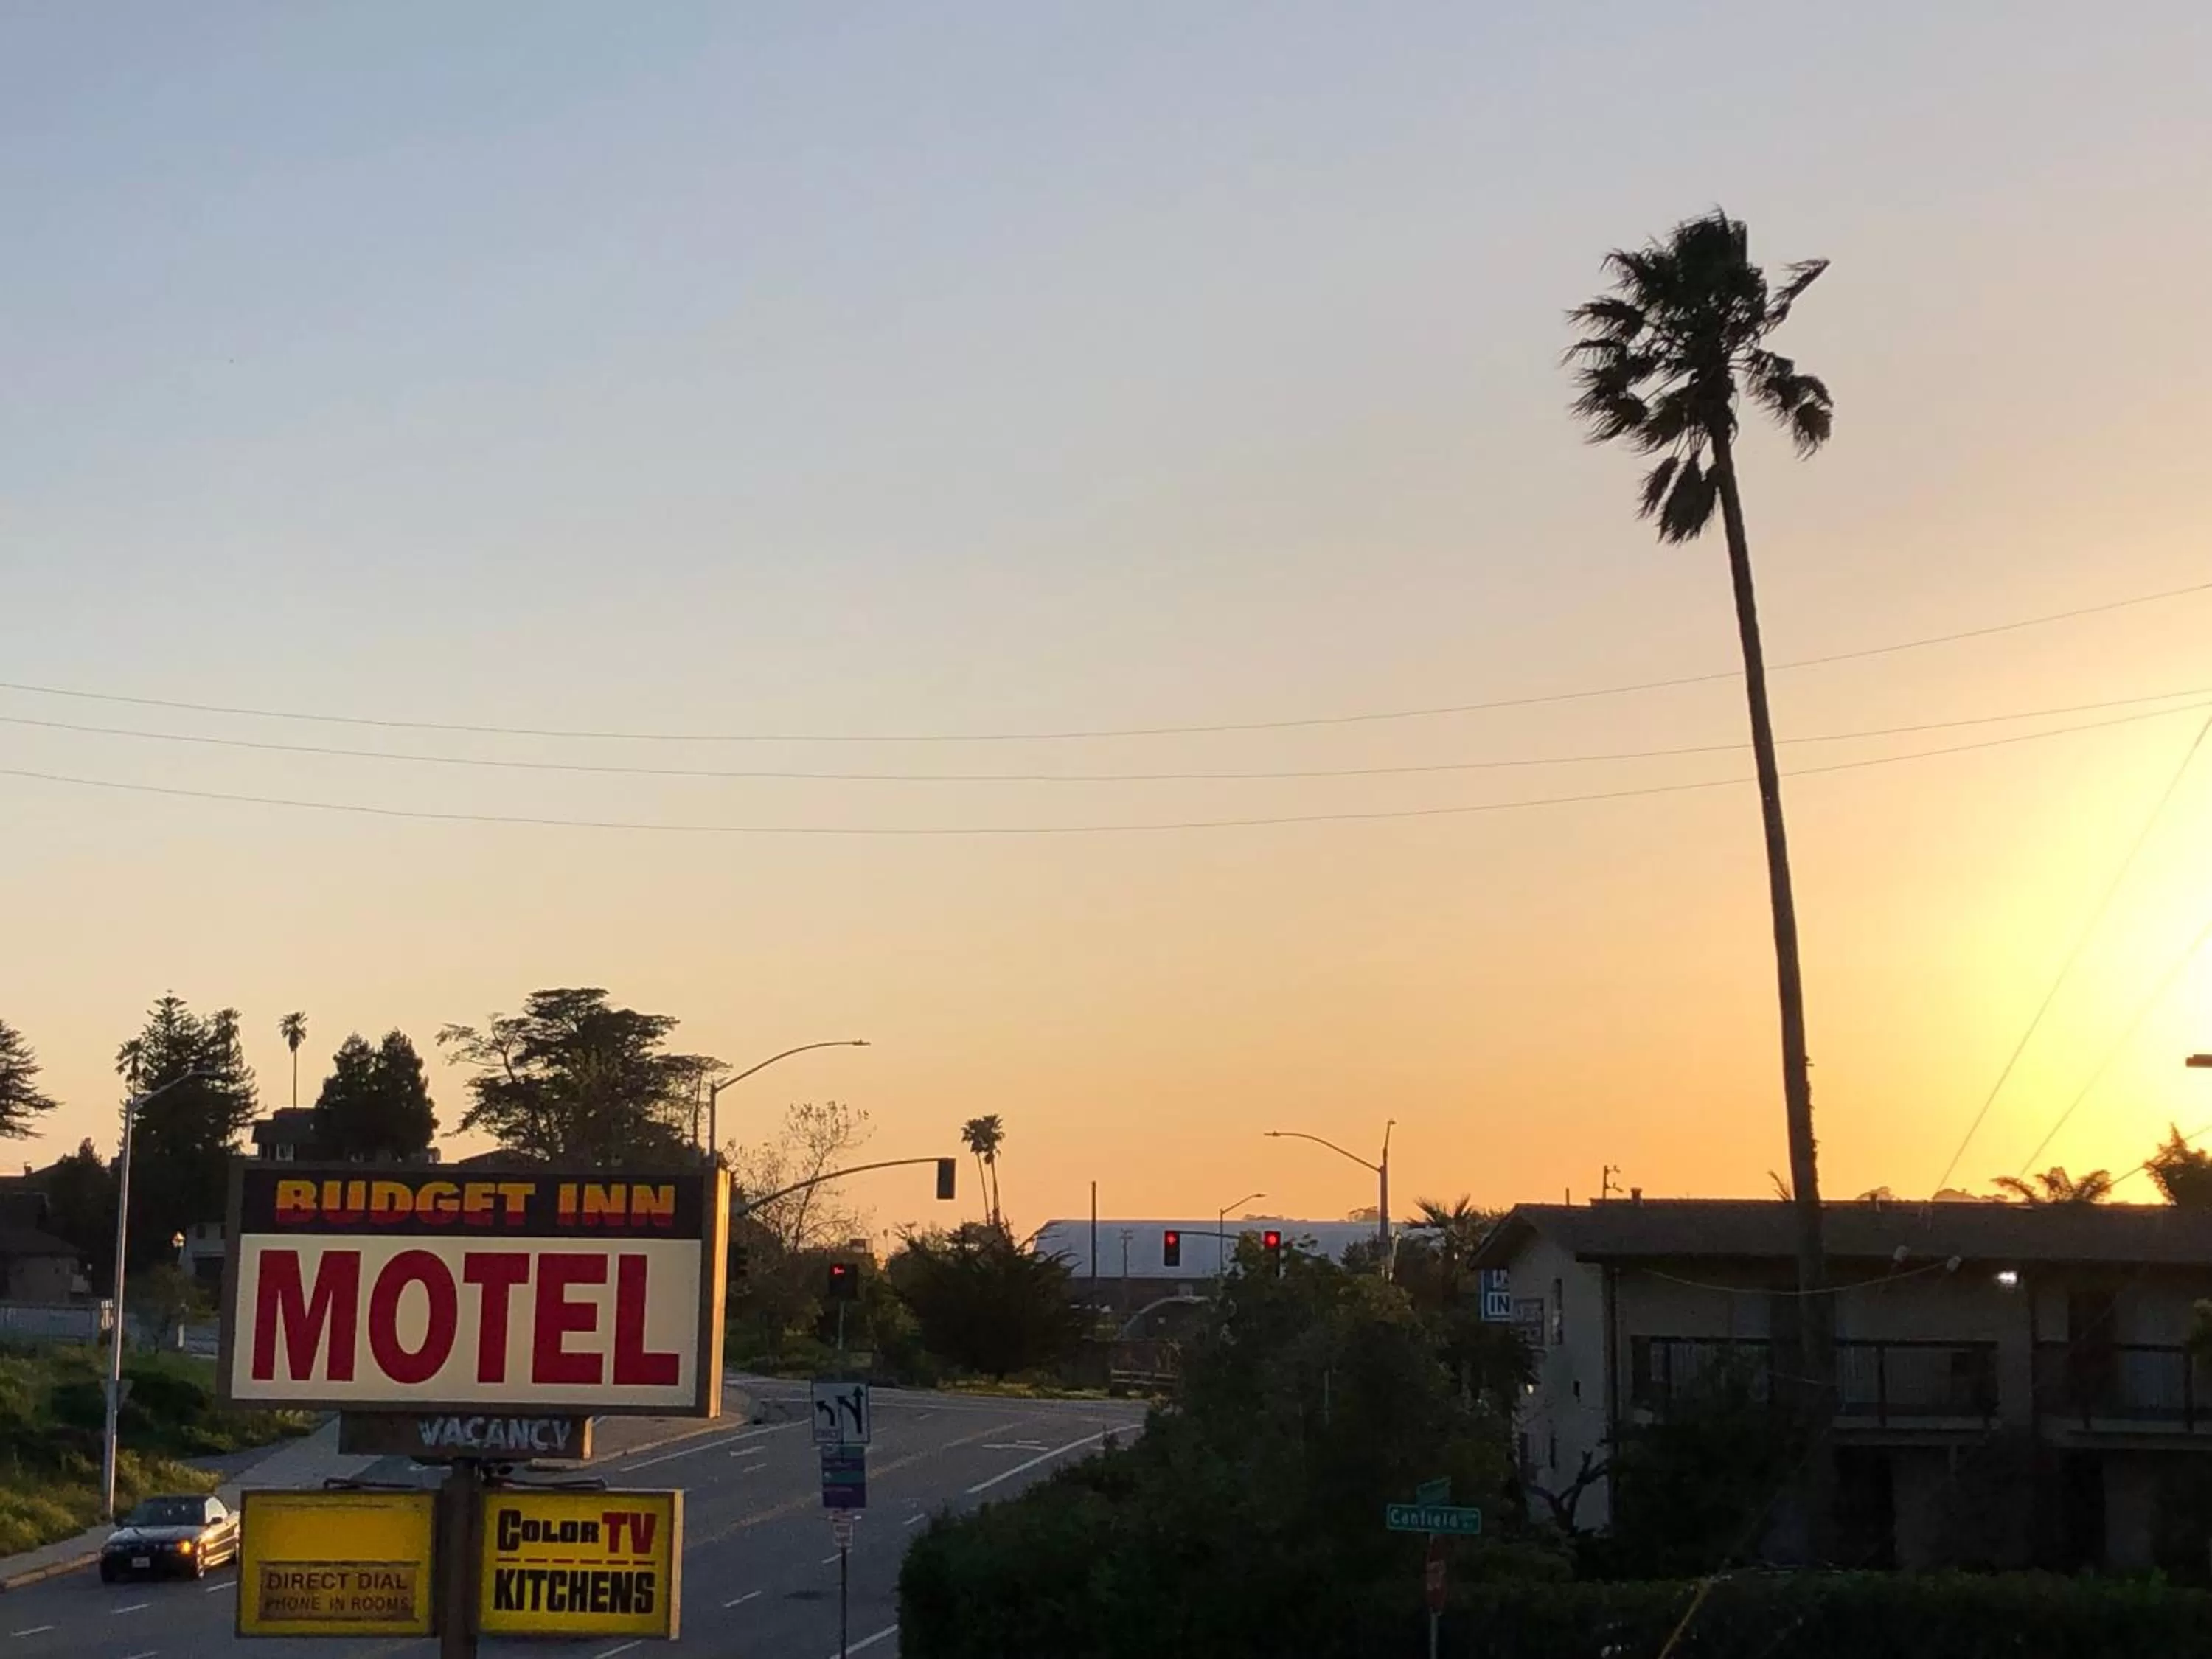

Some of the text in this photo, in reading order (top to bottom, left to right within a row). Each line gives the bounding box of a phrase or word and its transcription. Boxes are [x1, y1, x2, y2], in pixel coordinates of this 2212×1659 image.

[275, 1179, 675, 1228] BUDGET INN
[251, 1248, 680, 1386] MOTEL
[417, 1416, 571, 1450] VACANCY
[602, 1512, 656, 1554] TV
[266, 1571, 408, 1590] DIRECT DIAL
[493, 1569, 655, 1614] KITCHENS
[265, 1596, 409, 1612] PHONE IN ROOMS
